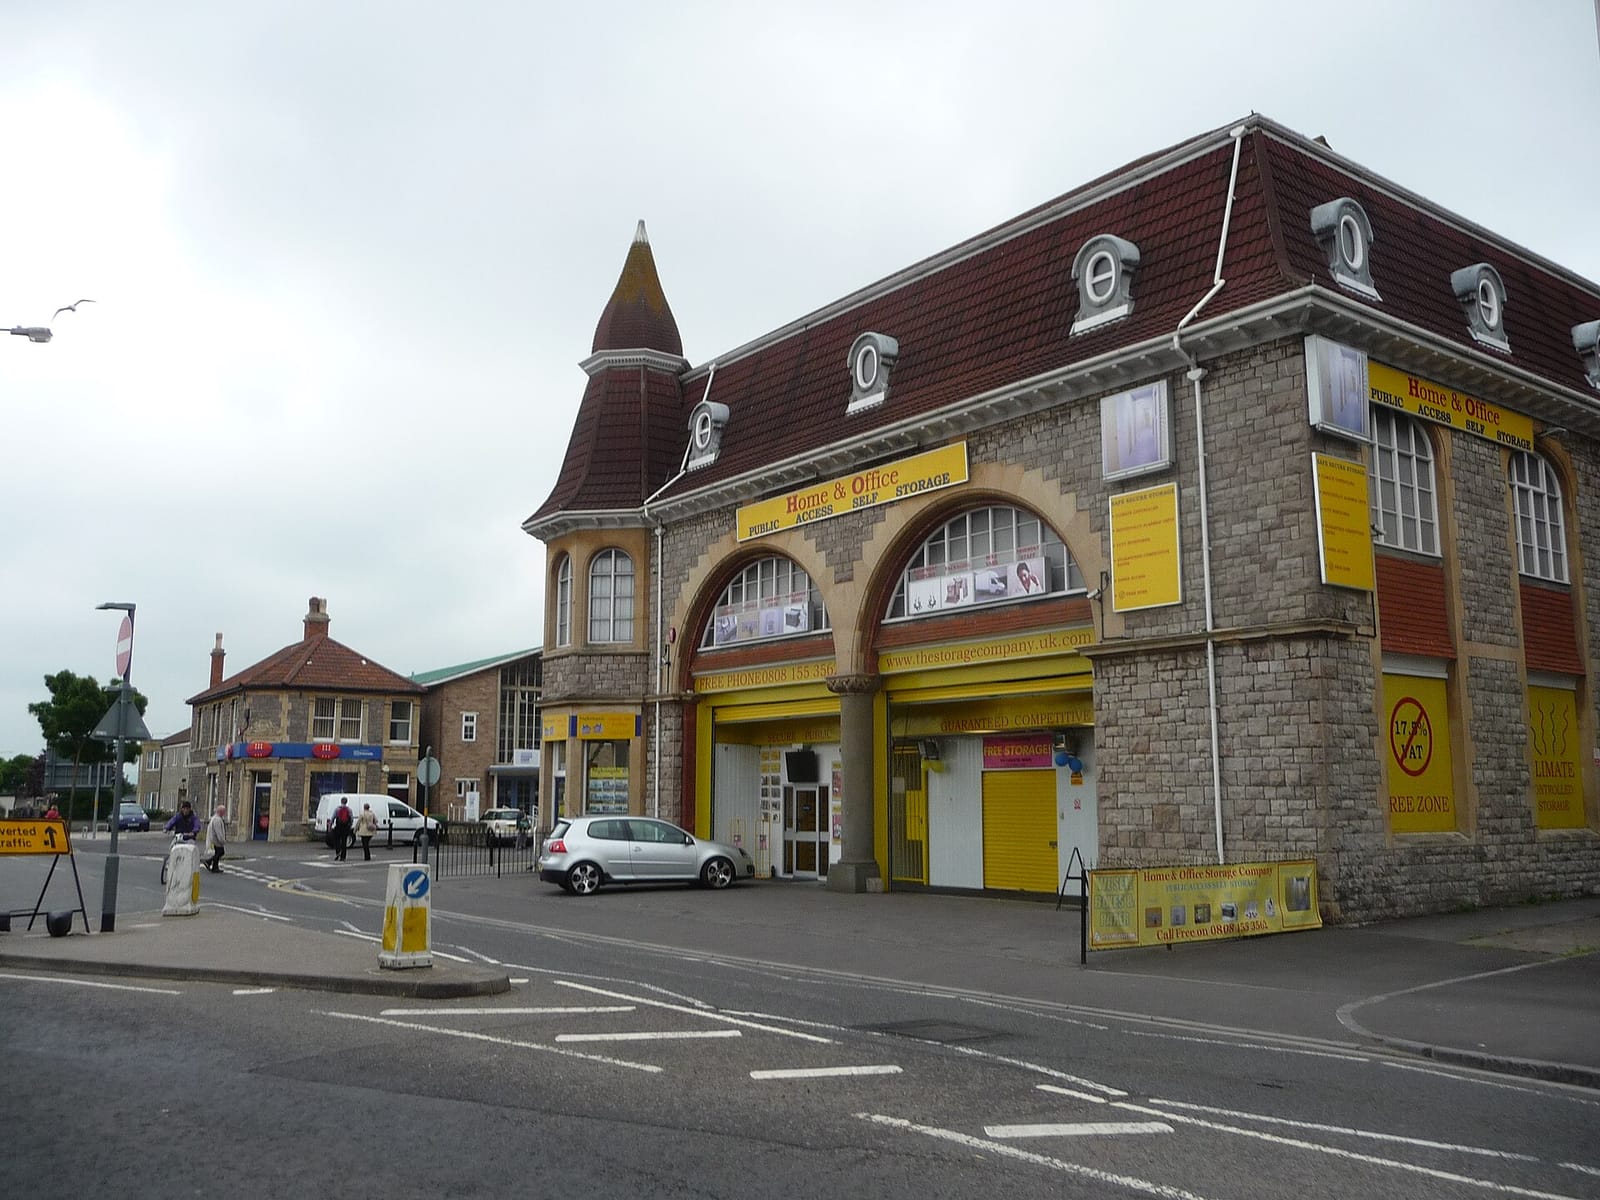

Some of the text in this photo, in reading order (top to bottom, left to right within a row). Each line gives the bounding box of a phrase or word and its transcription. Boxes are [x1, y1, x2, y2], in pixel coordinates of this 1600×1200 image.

[1408, 376, 1500, 425] Home & Office
[1371, 388, 1531, 450] PUBLIC ACCESS SELF STORAGE
[786, 468, 899, 514] Home & Office
[749, 472, 950, 537] PUBLIC ACCESS SELF STORAGE
[885, 631, 1092, 669] www.thestoragecompany.uk.com
[699, 676, 724, 691] FREE
[791, 663, 810, 681] 155
[813, 660, 837, 679] 356
[941, 711, 1091, 732] GUARANTEED COMPETITIVE
[1395, 720, 1428, 737] 17.5%
[984, 744, 1051, 757] FREE STORAGE!
[1401, 745, 1423, 760] VAT
[1417, 796, 1450, 813] ZONE
[1538, 800, 1570, 811] STORAGE
[0, 838, 32, 848] raffic
[1143, 871, 1170, 882] Home
[1179, 868, 1204, 881] Office
[1203, 867, 1237, 881] Storage
[1239, 866, 1273, 878] Company
[1156, 927, 1174, 941] Call
[1175, 927, 1195, 938] Free
[1210, 923, 1235, 936] 0808
